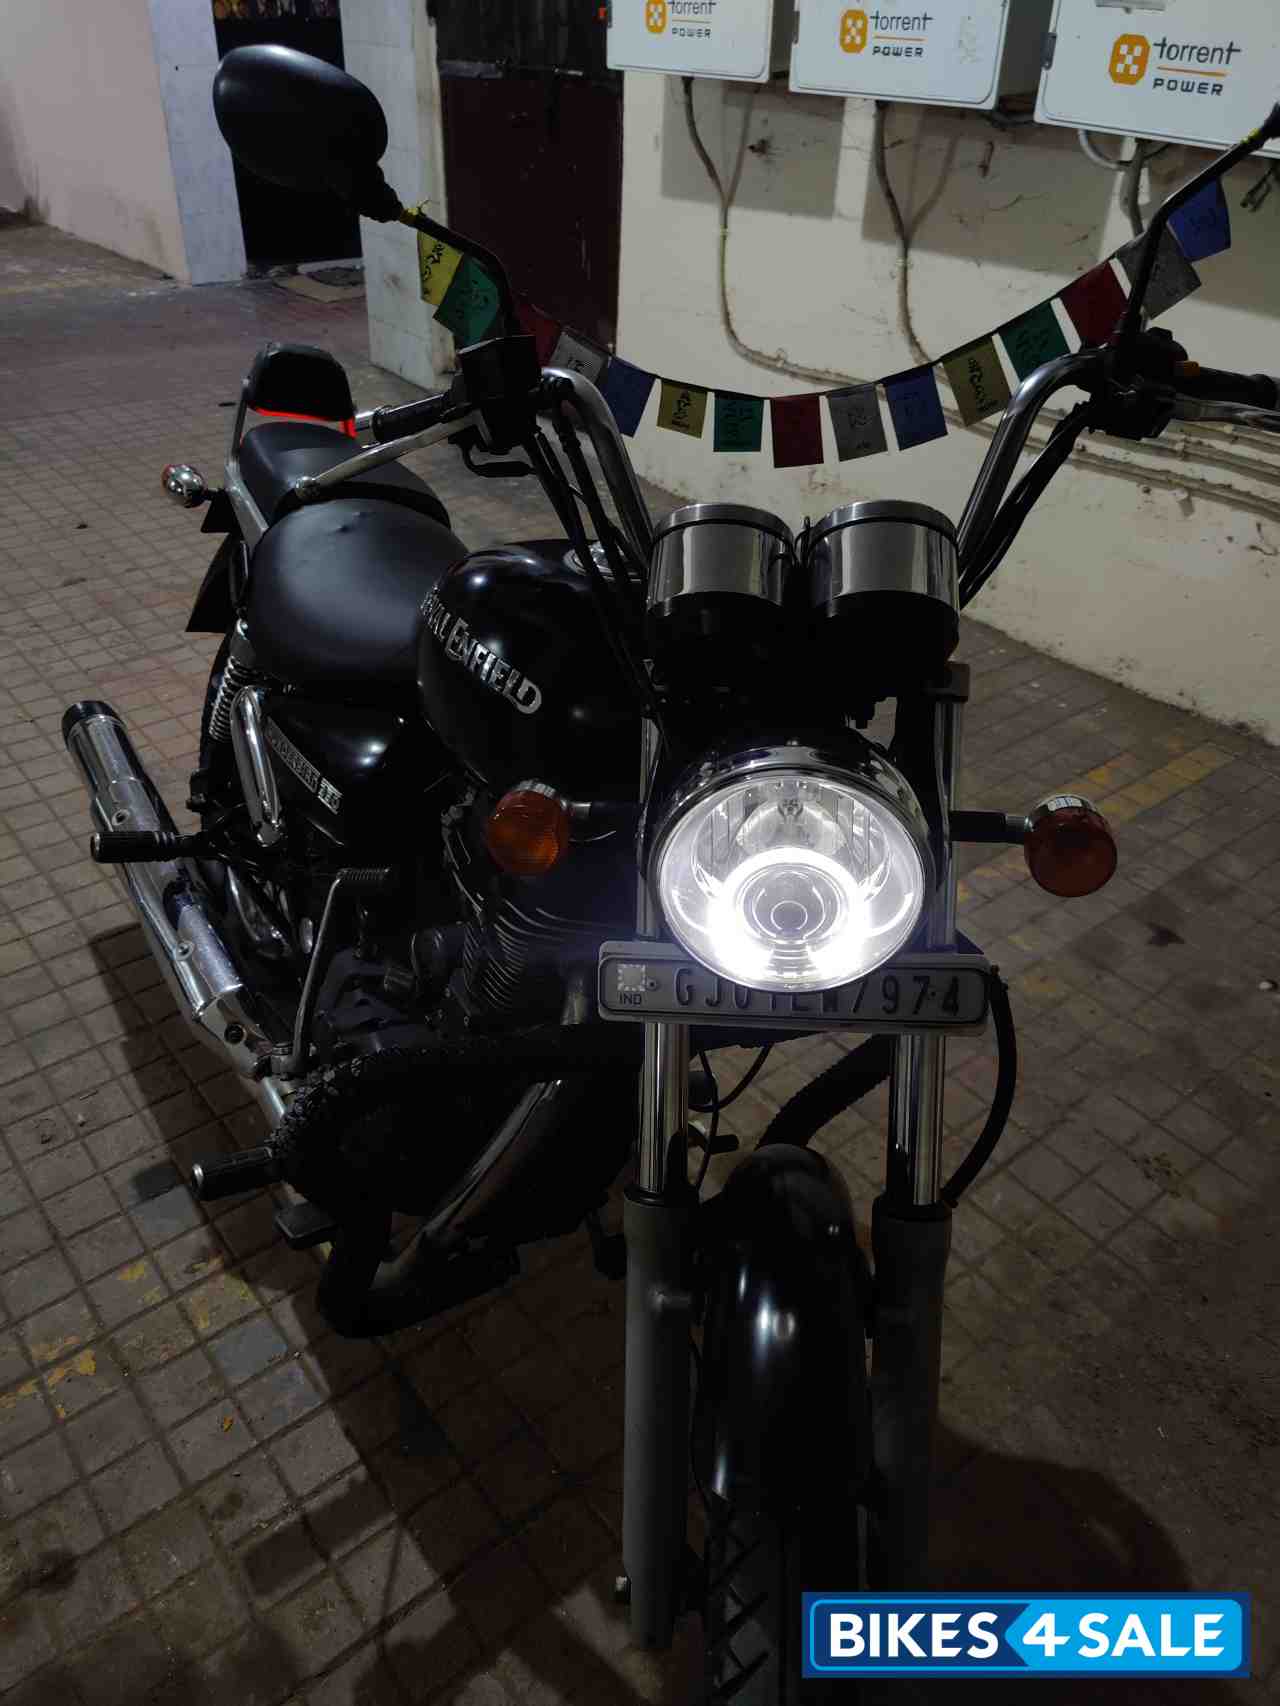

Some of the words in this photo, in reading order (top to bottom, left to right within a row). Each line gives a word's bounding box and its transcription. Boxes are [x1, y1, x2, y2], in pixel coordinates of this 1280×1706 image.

[668, 0, 717, 15] torrent
[869, 10, 933, 31] torrent
[671, 27, 711, 39] POWER
[872, 46, 925, 58] POWER
[1153, 36, 1242, 65] torrent
[1153, 78, 1224, 97] POWER
[445, 617, 542, 714] ENFIELD
[619, 993, 642, 1005] IND
